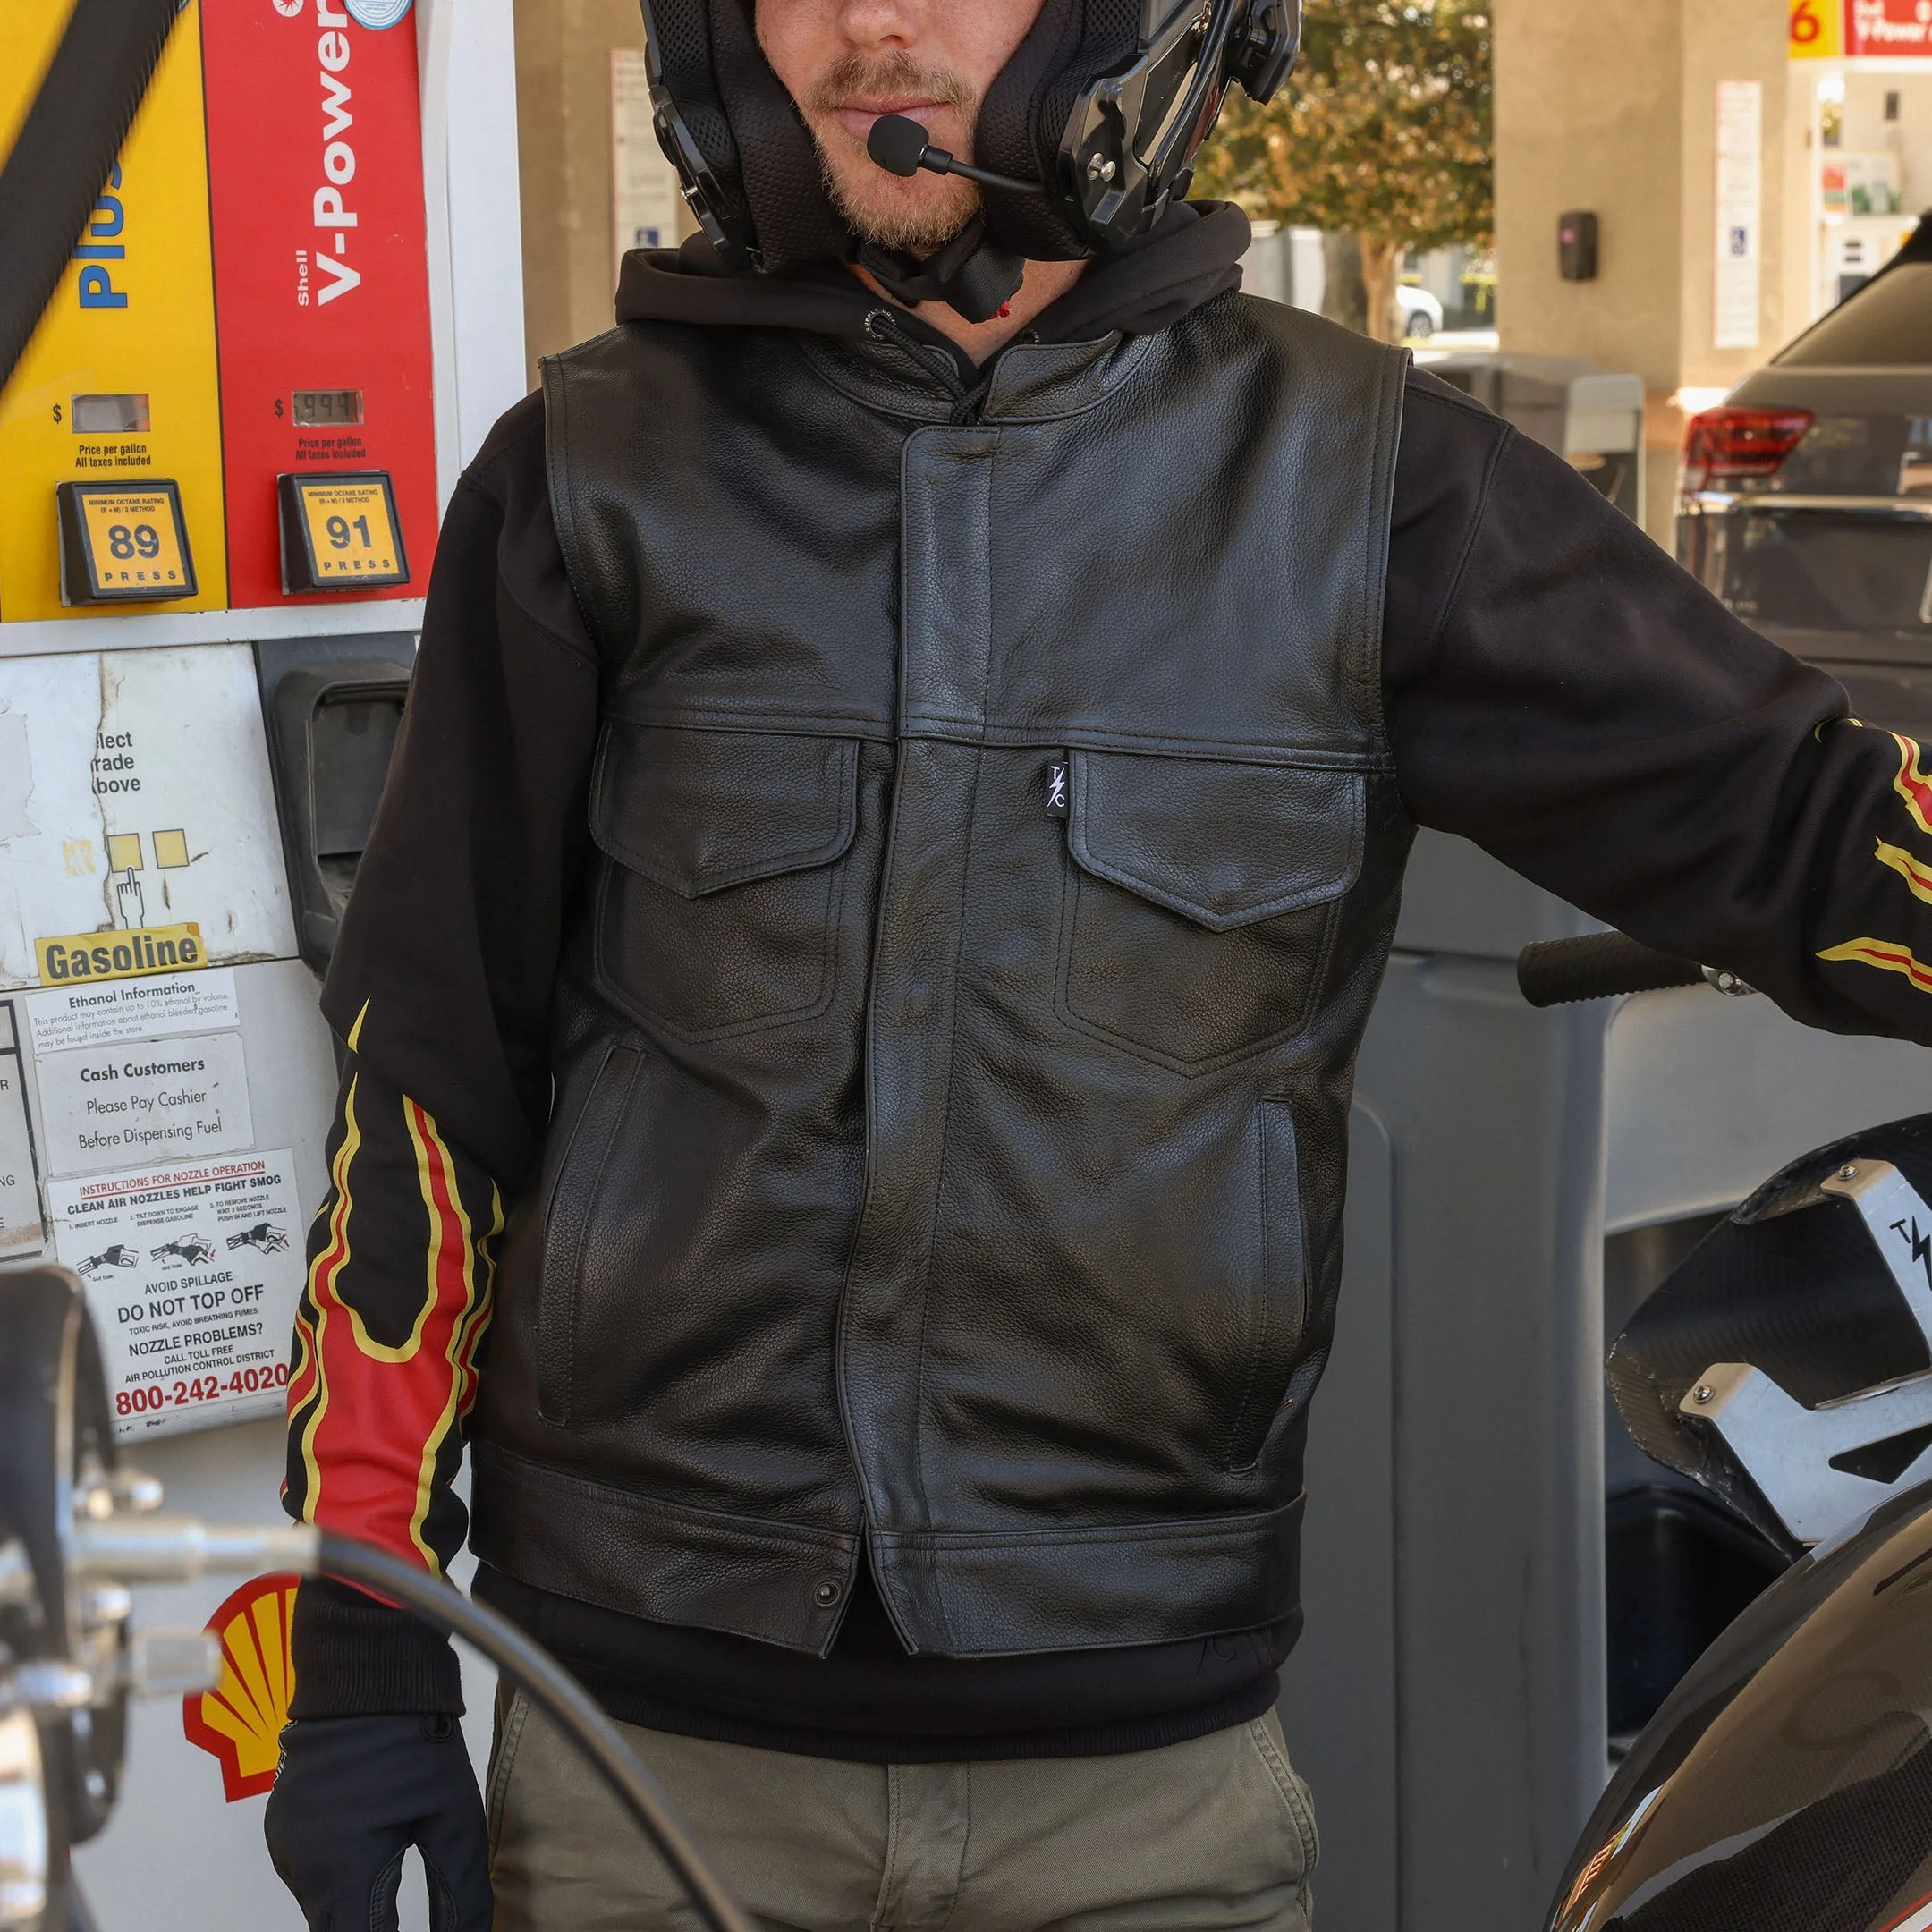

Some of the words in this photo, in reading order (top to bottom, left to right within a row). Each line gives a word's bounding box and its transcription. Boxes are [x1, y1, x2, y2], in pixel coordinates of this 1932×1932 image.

[314, 0, 360, 306] V-Power
[73, 159, 128, 309] Plu
[296, 250, 309, 306] Shell
[53, 403, 62, 424] $
[275, 399, 284, 419] $
[79, 445, 101, 455] Price
[104, 445, 117, 456] per
[121, 444, 147, 454] gallon
[299, 438, 318, 447] Price
[322, 439, 335, 448] per
[337, 436, 361, 447] gallon
[75, 457, 87, 468] All
[89, 457, 113, 467] taxes
[115, 455, 151, 466] included
[295, 451, 307, 460] All
[309, 450, 330, 459] taxes
[333, 449, 366, 458] included
[108, 524, 159, 559] 89
[326, 515, 371, 549] 91
[105, 570, 176, 581] PRESS
[324, 559, 390, 571] PRESS
[97, 732, 132, 749] lect
[90, 753, 134, 772] rade
[92, 777, 140, 794] bove
[46, 936, 198, 979] Gasoline
[69, 991, 117, 1009] Ethanol
[121, 982, 195, 1001] Information
[34, 1017, 48, 1026] This
[50, 1013, 78, 1024] product
[80, 1011, 95, 1019] may
[97, 1005, 123, 1016] contain
[125, 1004, 135, 1013] up
[146, 999, 163, 1008] 10%
[165, 996, 191, 1006] ethanol
[192, 995, 201, 1004] by
[37, 1022, 74, 1038] Additional
[76, 1020, 116, 1031] information
[118, 1014, 139, 1024] about
[140, 1010, 166, 1021] ethanol
[168, 1007, 197, 1017] blended
[199, 1004, 228, 1016] gasoline
[38, 1040, 54, 1049] may
[55, 1037, 65, 1046] be
[89, 1030, 112, 1039] inside
[113, 1028, 124, 1036] the
[80, 1064, 118, 1082] Cash
[123, 1059, 205, 1078] Customers
[87, 1098, 127, 1114] Please
[131, 1095, 155, 1113] Pay
[158, 1089, 207, 1106] Cashier
[79, 1131, 121, 1148] Before
[123, 1123, 193, 1145] Dispensing
[196, 1116, 222, 1135] Fuel
[80, 1177, 149, 1196] INSTRUCTIONS
[152, 1174, 171, 1185] FOR
[174, 1169, 210, 1182] NOZZLE
[212, 1160, 265, 1178] OPERATION
[67, 1200, 105, 1216] CLEAN
[108, 1196, 127, 1208] AIR
[130, 1189, 180, 1206] NOZZLES
[183, 1185, 212, 1198] HELP
[215, 1180, 247, 1193] FIGHT
[250, 1174, 282, 1188] SMOG
[224, 1198, 248, 1206] REMOVE
[248, 1194, 270, 1202] NOZZLE
[148, 1209, 166, 1217] DOWN
[175, 1205, 199, 1214] ENGAGE
[235, 1203, 263, 1212] SECONDS
[266, 1207, 287, 1215] NOZZLE
[74, 1220, 95, 1229] INSERT
[96, 1217, 118, 1225] NOZZLE
[137, 1217, 165, 1227] DISPENSE
[165, 1213, 194, 1223] GASOLINE
[144, 1280, 178, 1295] AVOID
[181, 1271, 233, 1289] SPILLAGE
[117, 1304, 144, 1324] DO
[149, 1297, 186, 1318] NOT
[190, 1291, 225, 1312] TOP
[231, 1284, 265, 1304] OFF
[129, 1324, 150, 1335] TOXIC
[151, 1322, 171, 1333] RISK,
[172, 1318, 193, 1328] AVOID
[194, 1311, 233, 1326] BREATHING
[234, 1307, 258, 1318] FUMES
[129, 1336, 182, 1357] NOZZLE
[184, 1322, 264, 1347] PROBLEMS?
[164, 1354, 187, 1365] CALL
[188, 1350, 210, 1361] TOLL
[211, 1344, 234, 1356] FREE
[125, 1372, 140, 1384] AIR
[142, 1363, 191, 1381] POLLUTION
[192, 1356, 234, 1371] CONTROL
[236, 1349, 275, 1364] DISTRICT
[115, 1363, 289, 1416] 800-242-4020
